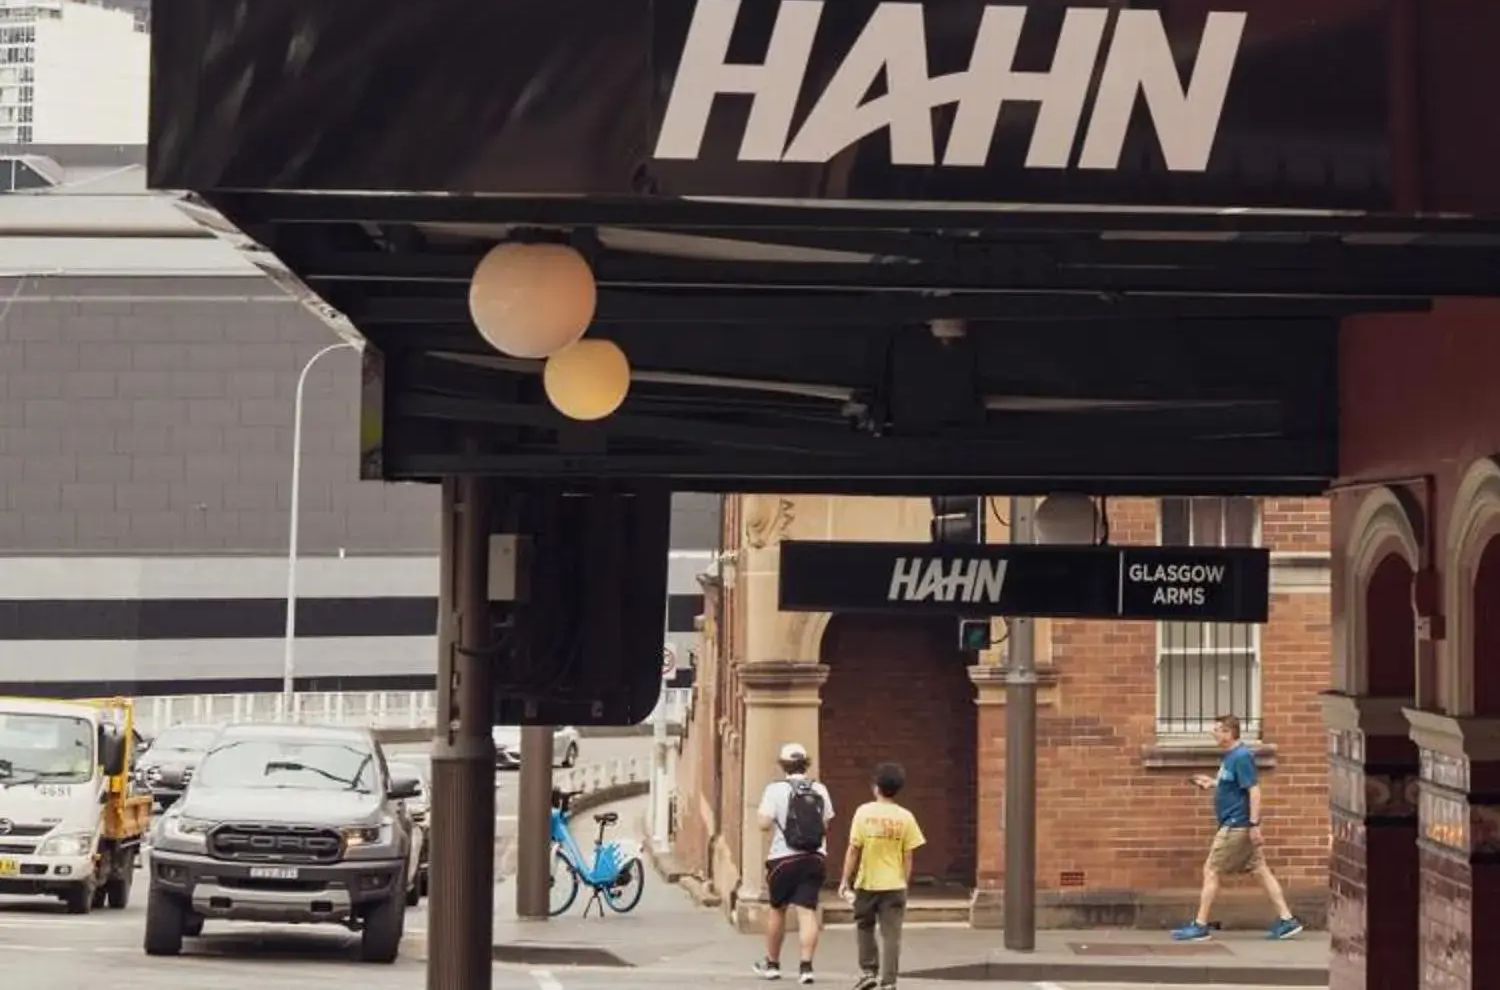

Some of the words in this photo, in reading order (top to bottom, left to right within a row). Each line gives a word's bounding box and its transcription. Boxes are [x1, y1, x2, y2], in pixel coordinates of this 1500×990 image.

[887, 557, 1008, 603] HAHN
[1129, 564, 1225, 584] GLASGOW
[1152, 586, 1205, 605] ARMS
[216, 834, 338, 848] FORD
